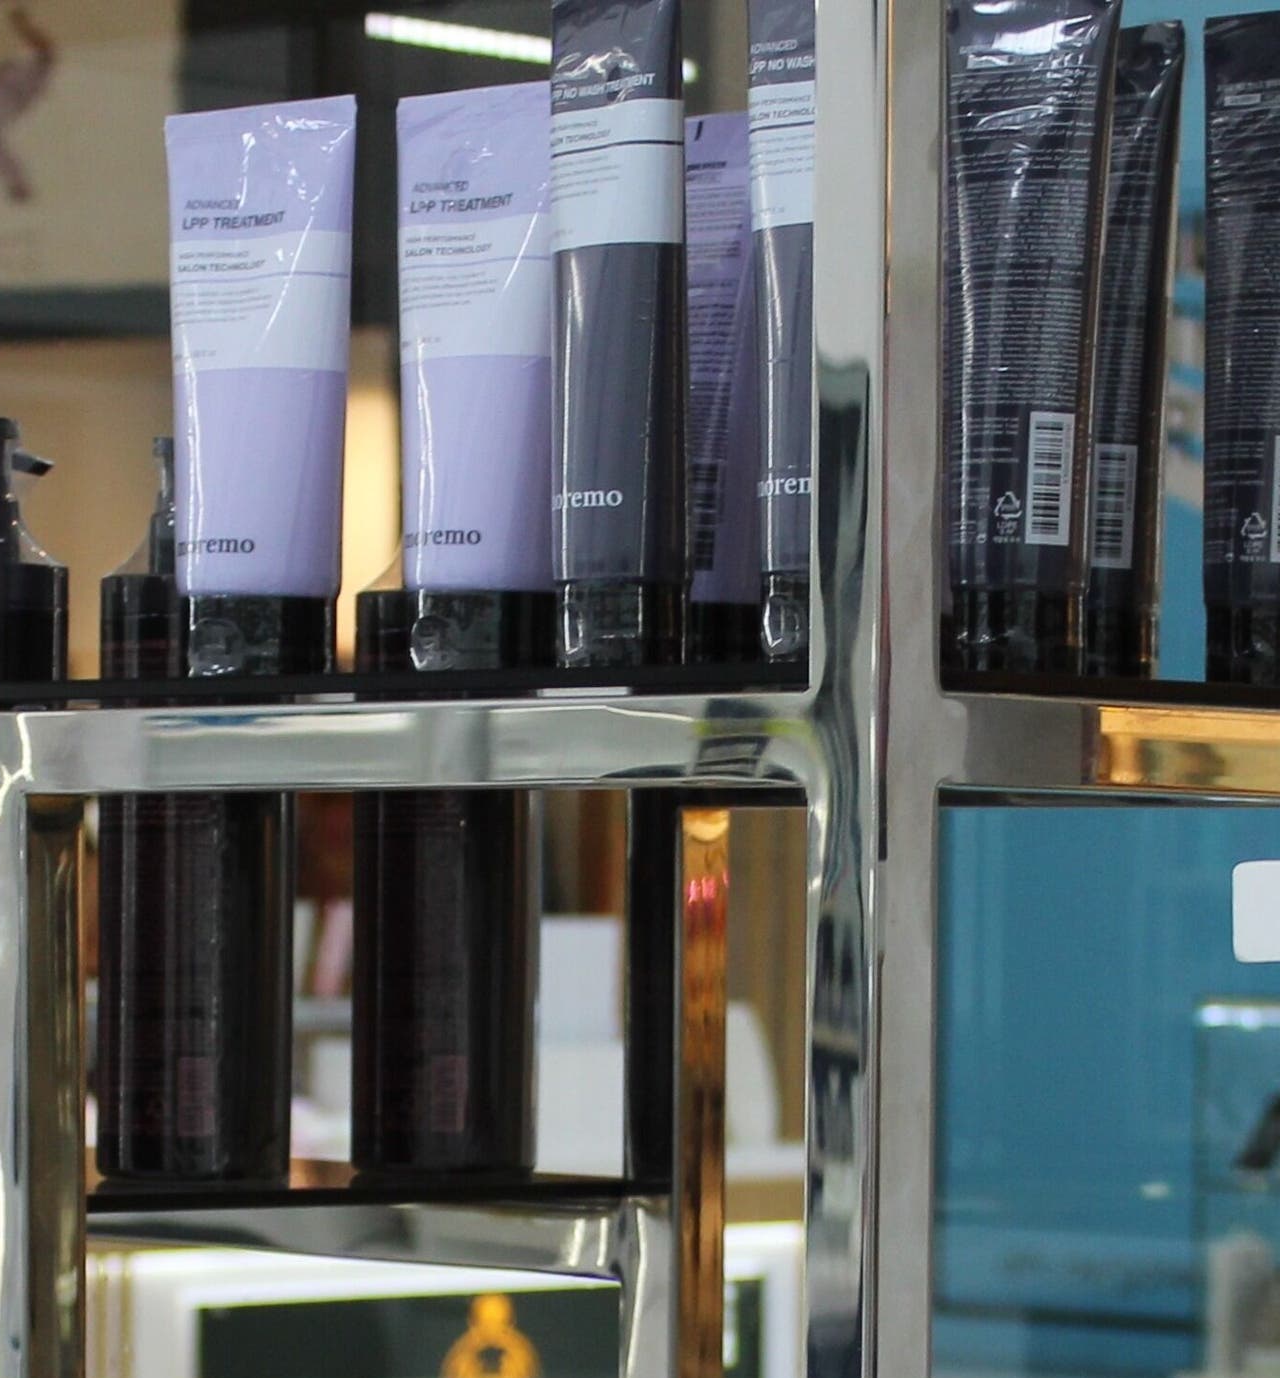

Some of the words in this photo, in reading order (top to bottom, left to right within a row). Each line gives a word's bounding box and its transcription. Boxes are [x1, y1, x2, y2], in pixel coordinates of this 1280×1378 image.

[768, 59, 785, 71] NO
[440, 193, 515, 212] TREATMENT
[182, 216, 209, 231] LPP
[213, 211, 287, 230] TREATMENT
[177, 264, 207, 273] SALON
